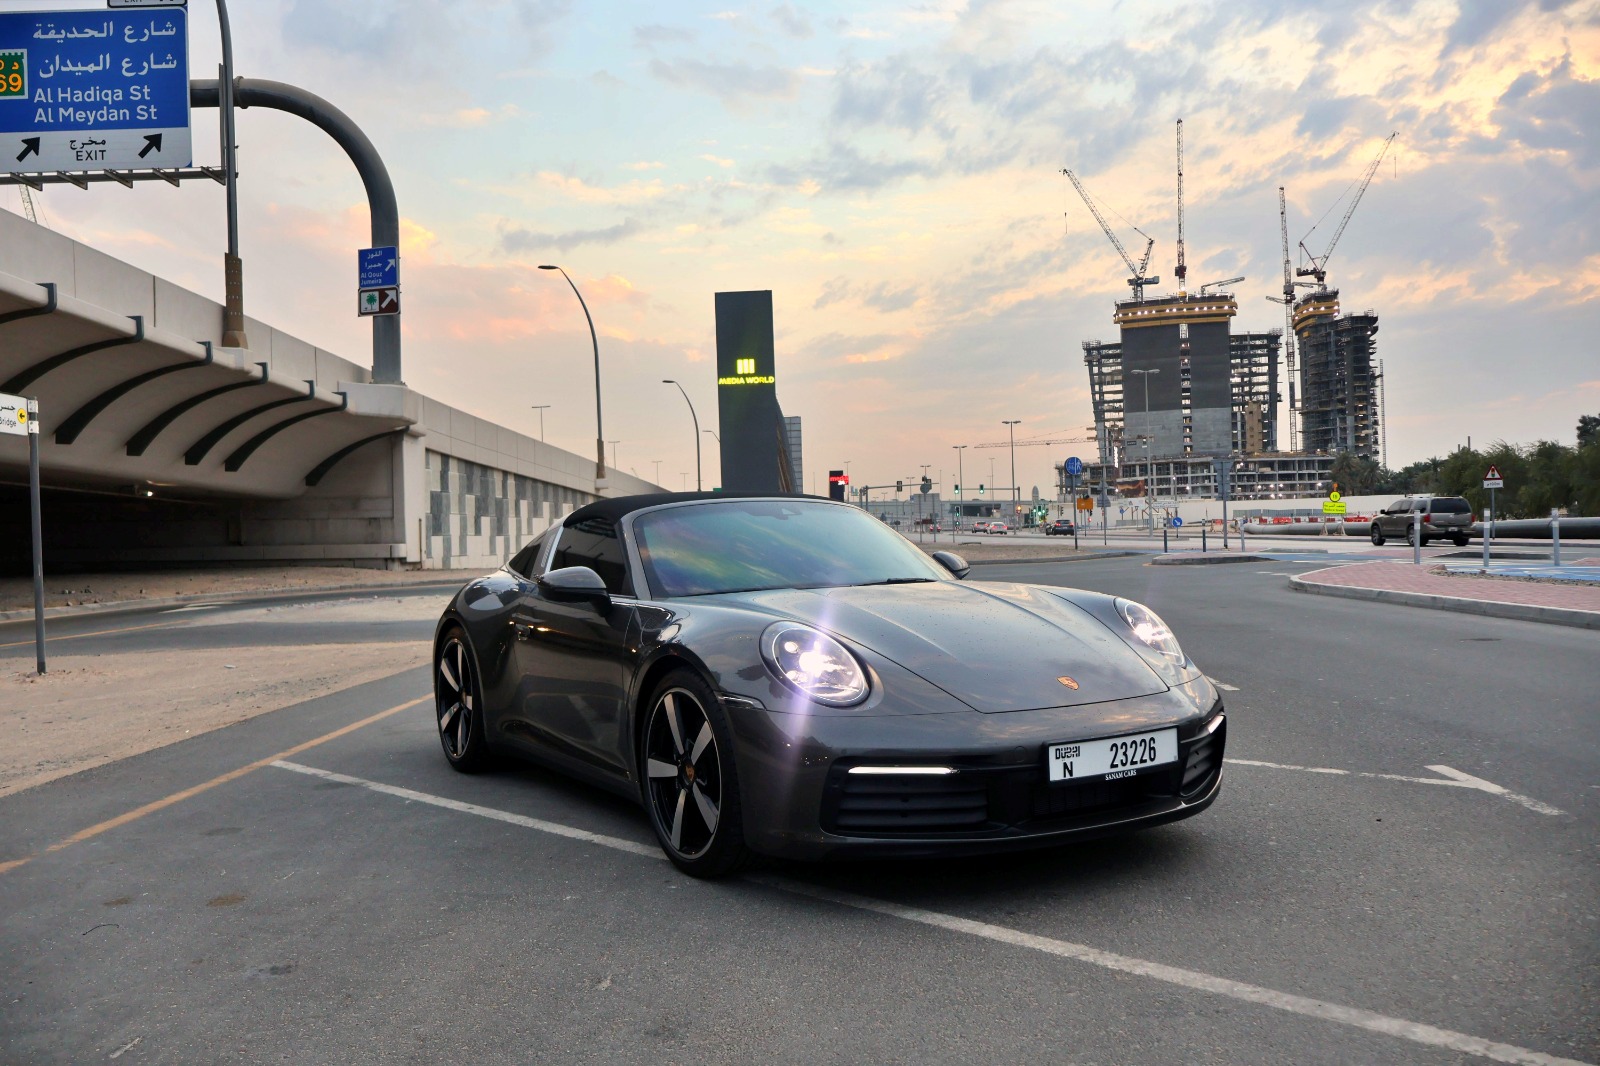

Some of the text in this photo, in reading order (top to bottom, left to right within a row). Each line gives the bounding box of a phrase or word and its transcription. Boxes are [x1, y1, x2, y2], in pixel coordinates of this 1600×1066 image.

[32, 20, 177, 43] شارع الحديقة
[39, 52, 178, 78] شارع الميدان
[33, 84, 151, 105] Al Hadiqa St
[34, 105, 158, 125] Al Meydan St
[69, 136, 107, 150] مخرج
[75, 150, 107, 162] EXIT
[718, 376, 775, 385] MEDIA WORLD
[1110, 737, 1156, 769] 23226
[1062, 760, 1074, 779] N
[1105, 769, 1137, 781] SANAM CARS
